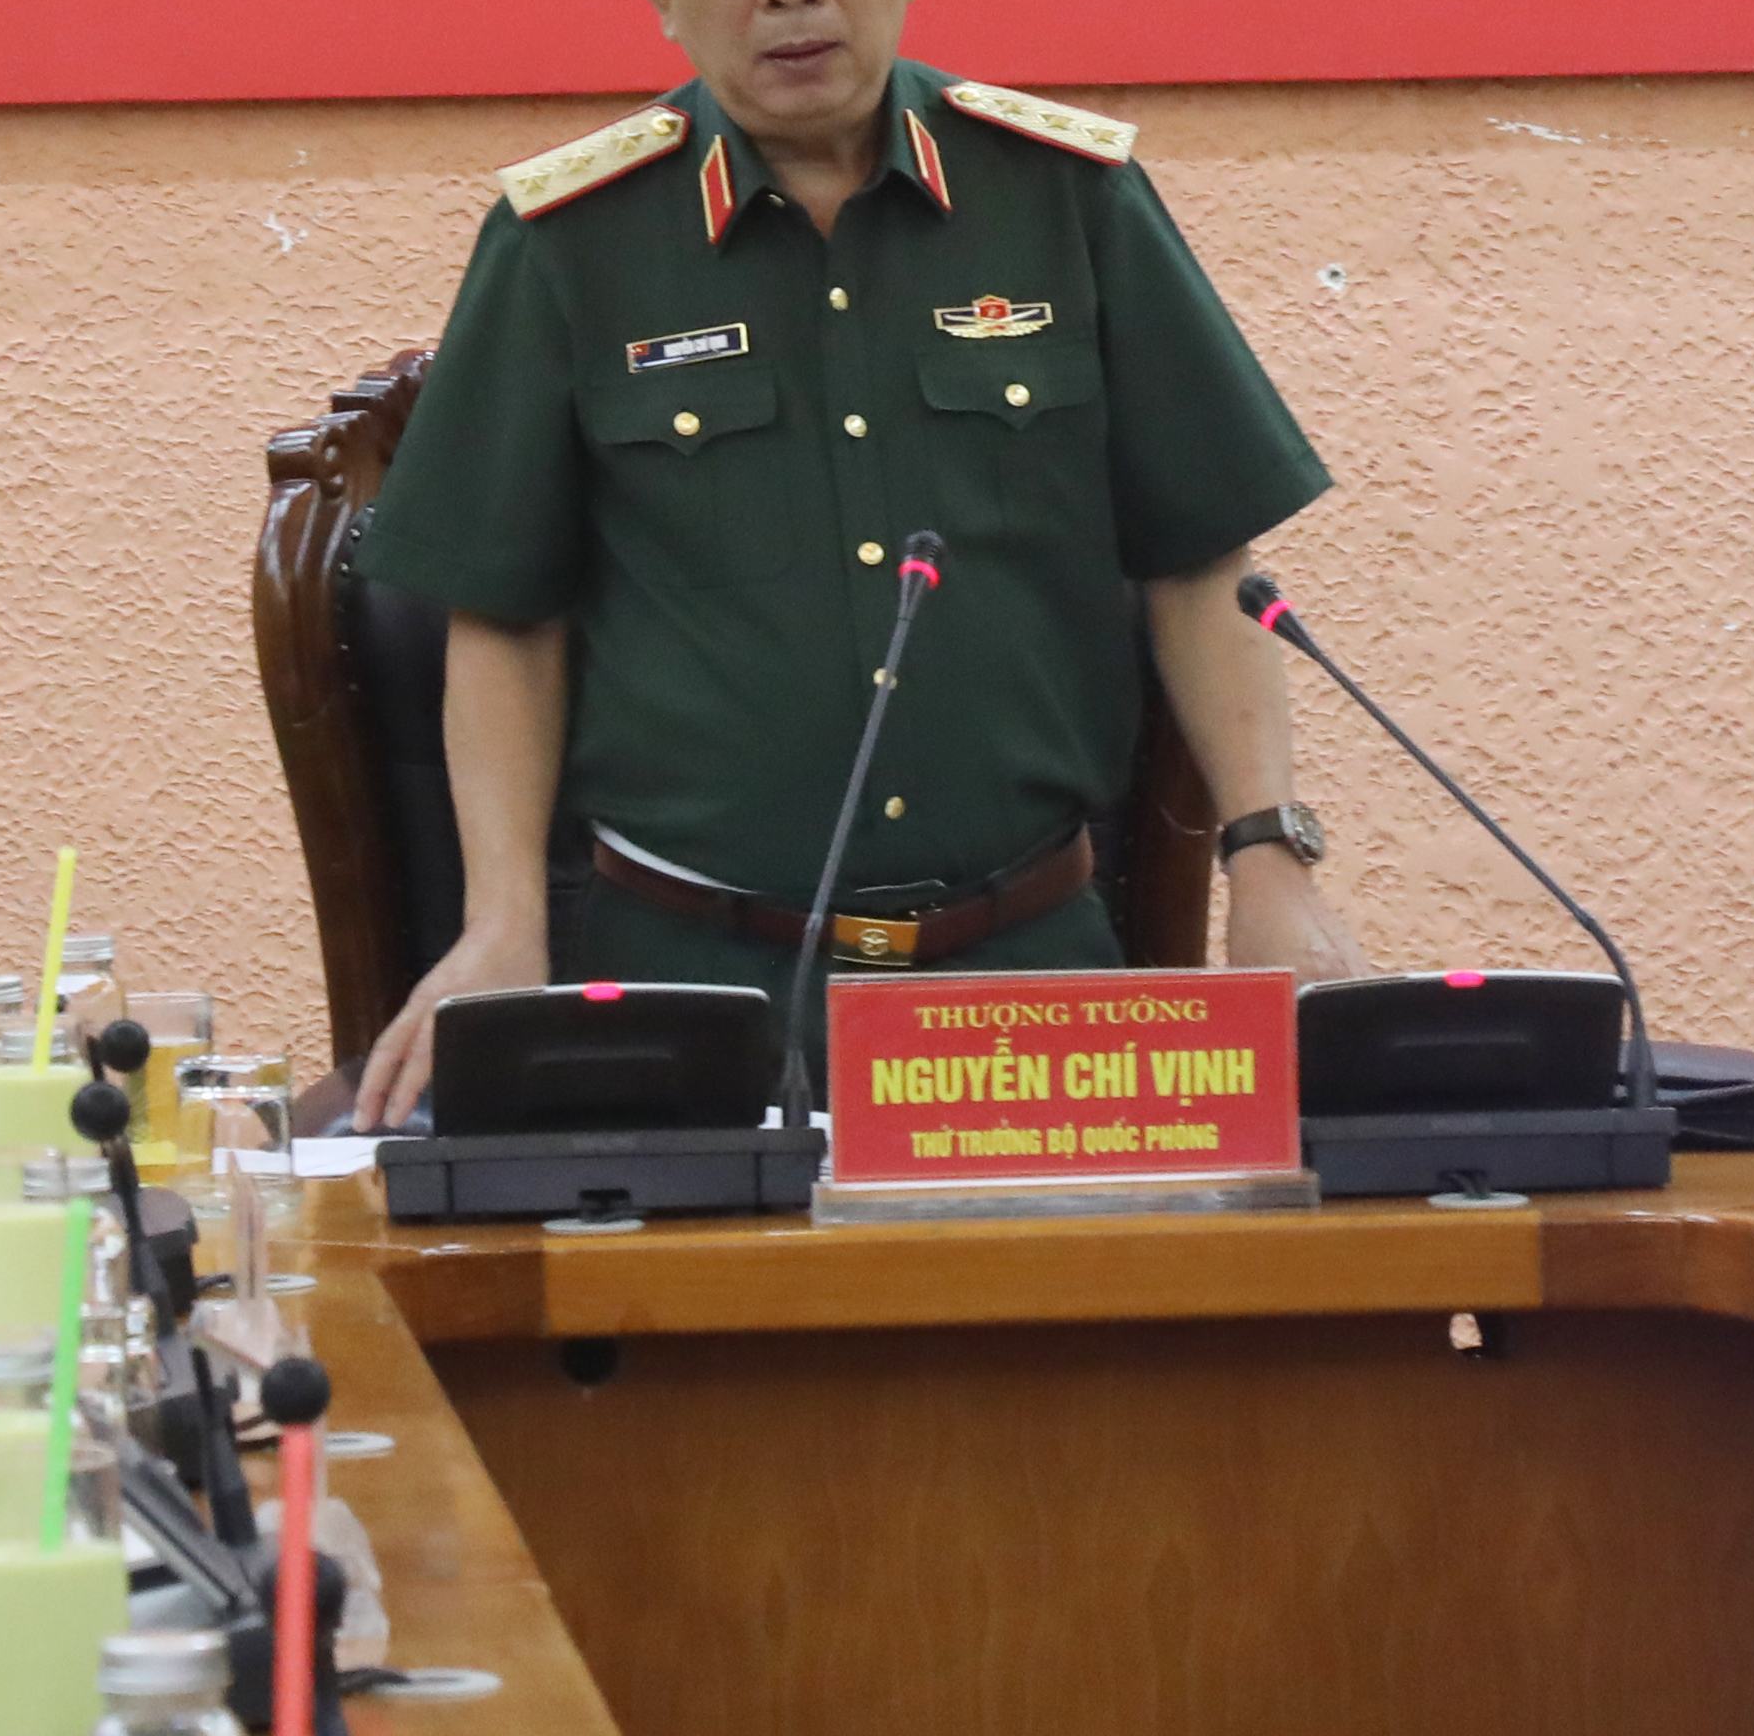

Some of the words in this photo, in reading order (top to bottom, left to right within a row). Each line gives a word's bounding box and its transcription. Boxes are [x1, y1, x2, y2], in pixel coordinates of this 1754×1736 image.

[915, 1002, 1072, 1033] THƯỢNG
[1079, 993, 1209, 1025] TƯỚNG
[871, 1036, 1051, 1105] NGUYỄN
[1064, 1040, 1137, 1100] CHÍ
[1150, 1047, 1256, 1107] VỊNH
